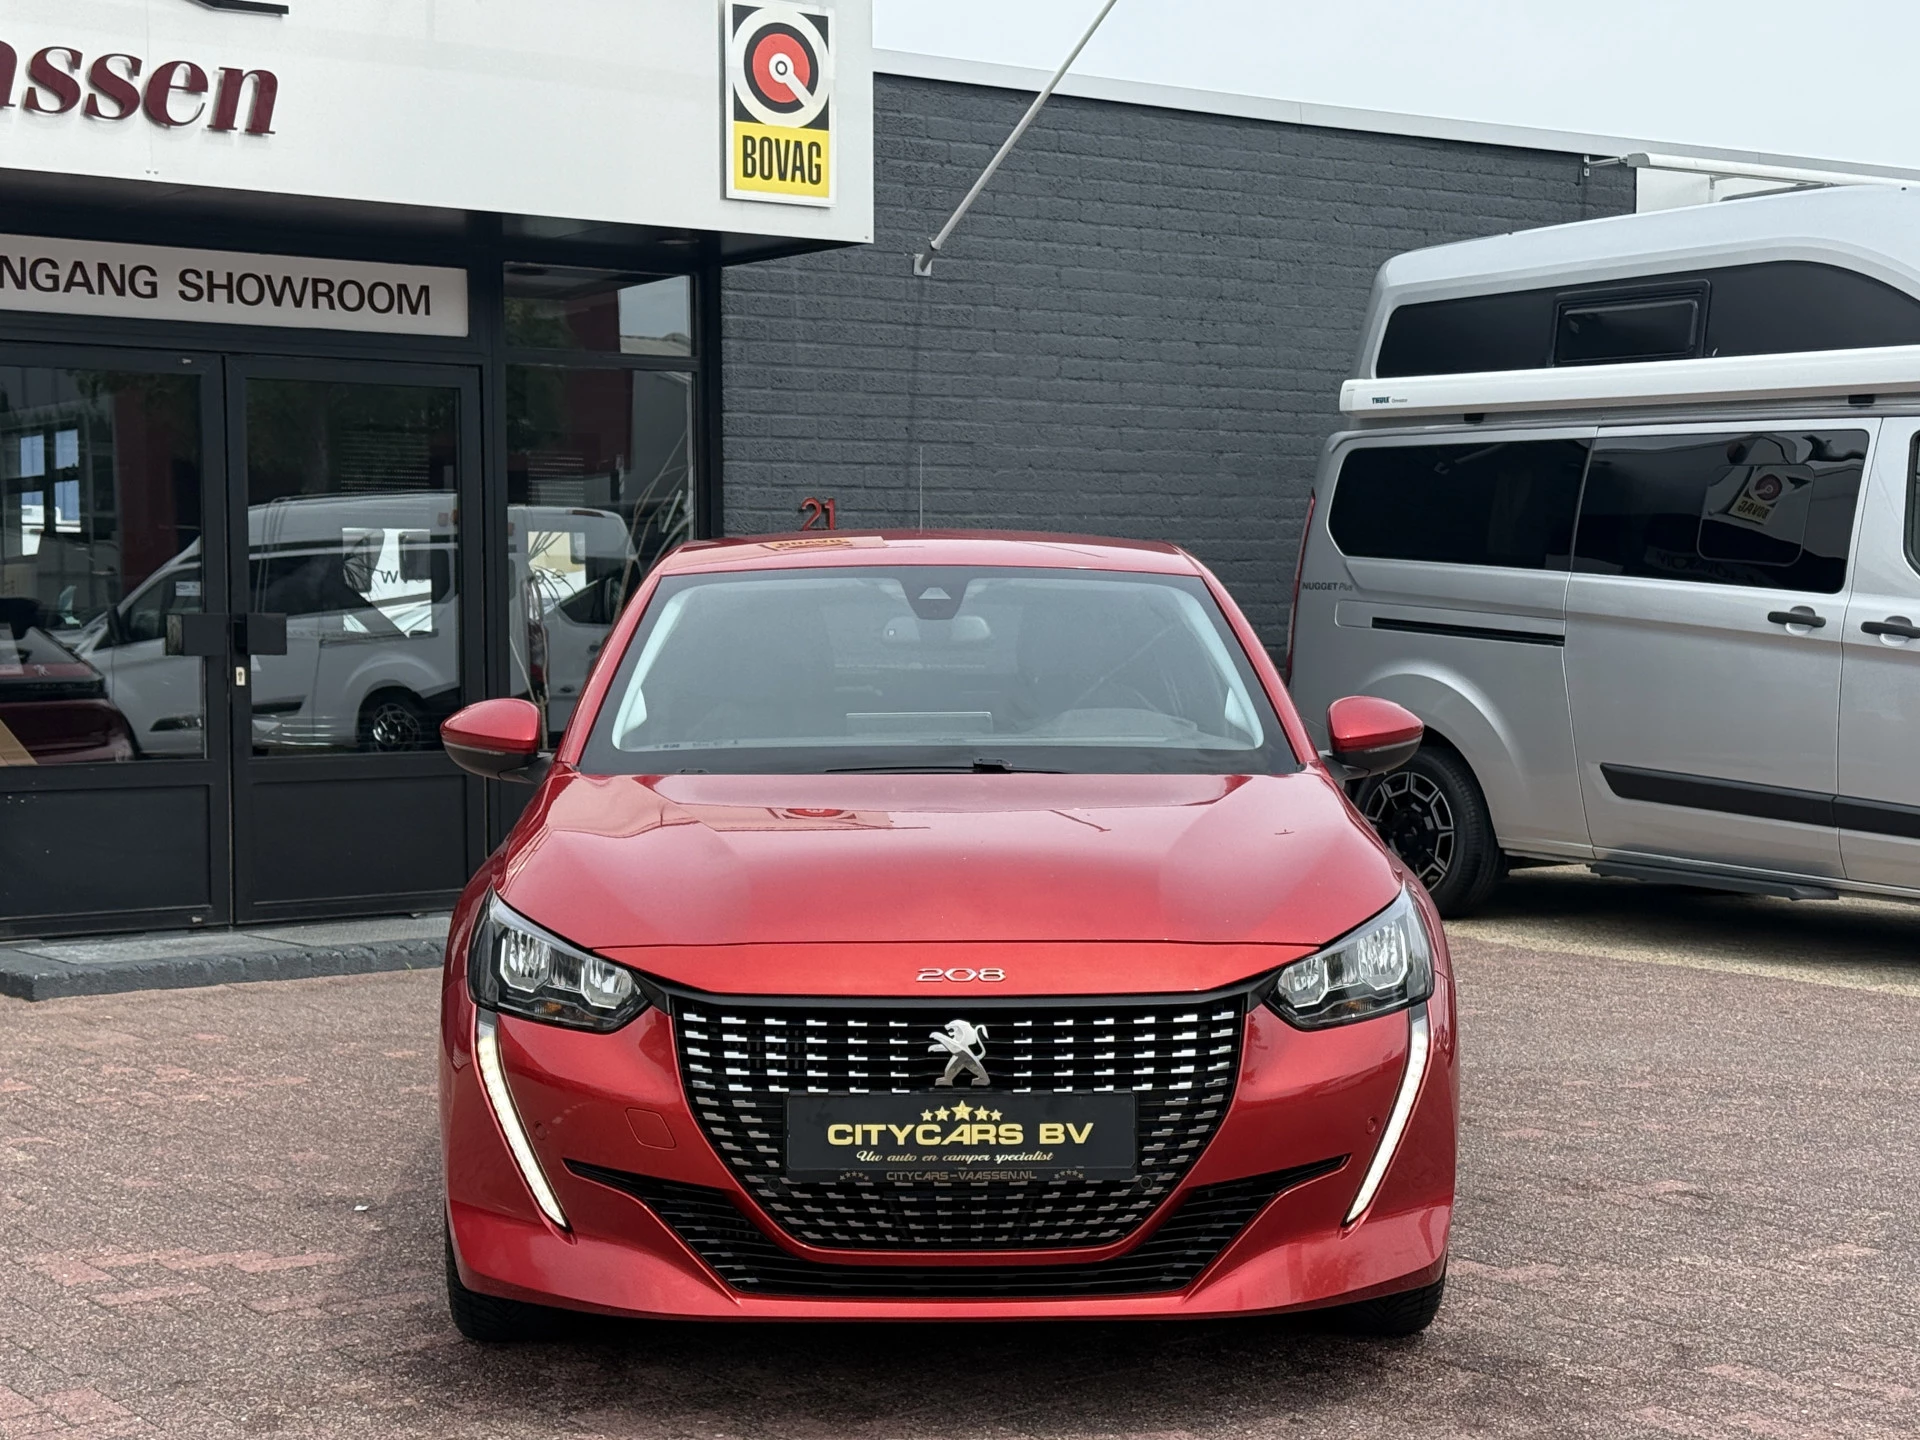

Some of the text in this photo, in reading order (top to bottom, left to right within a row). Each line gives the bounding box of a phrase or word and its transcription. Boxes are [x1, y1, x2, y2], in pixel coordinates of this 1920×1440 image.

[742, 134, 822, 186] BOVAG
[0, 255, 431, 316] NGANG SHOWROOM
[801, 497, 836, 531] 21
[1302, 582, 1338, 591] NUGGET
[915, 967, 1006, 983] 208
[827, 1122, 1094, 1146] CITYCARS BV
[855, 1150, 1054, 1165] Uw auto en camper specialist
[886, 1170, 1038, 1181] CITYCARS-VAASSEN.NL
